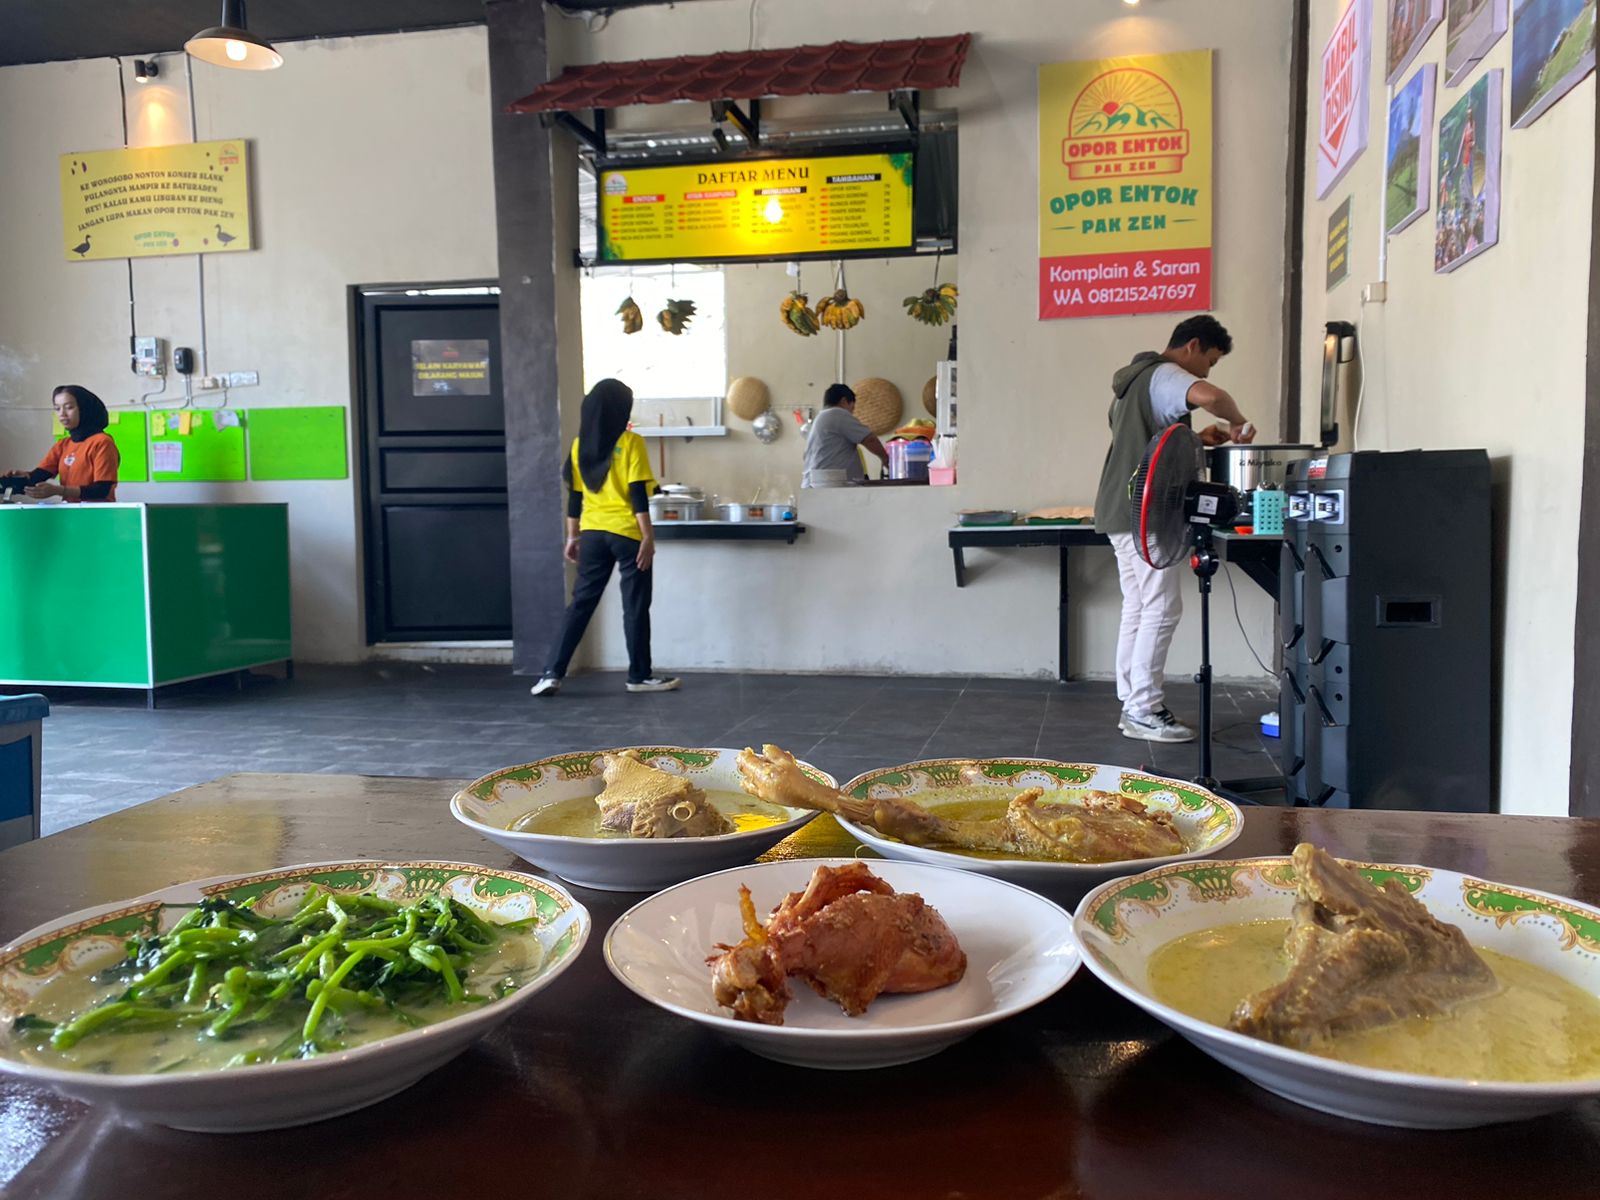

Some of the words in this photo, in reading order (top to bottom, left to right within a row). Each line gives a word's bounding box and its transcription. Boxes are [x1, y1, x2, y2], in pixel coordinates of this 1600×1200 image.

[1324, 10, 1358, 101] AMBIL
[1325, 60, 1353, 137] DISINI
[1068, 140, 1118, 158] OPOR
[1122, 136, 1184, 154] ENTOK
[697, 169, 758, 184] DAFTAR
[763, 166, 809, 181] MENU
[1094, 163, 1122, 174] PAK
[1129, 160, 1156, 172] ZEN
[80, 182, 90, 192] KE
[90, 172, 134, 188] WONOSOBO
[134, 170, 166, 179] NONTON
[167, 171, 198, 179] KONSER
[832, 174, 875, 182] TAMBAHAN
[84, 186, 128, 202] PULANGNYA
[129, 182, 159, 192] MAMPIR
[172, 182, 218, 192] BATURADEN
[103, 197, 128, 209] KALAU
[129, 195, 152, 203] KAMU
[153, 194, 187, 202] LIBURAN
[200, 195, 224, 205] DIENG
[1050, 187, 1113, 214] OPOR
[1120, 184, 1199, 206] ENTOK
[78, 216, 105, 232] JANGAN
[106, 212, 125, 222] LUPA
[126, 207, 152, 217] MAKAN
[153, 206, 175, 214] OPOR
[177, 206, 202, 215] ENTOK
[203, 208, 219, 217] PAK
[220, 210, 235, 219] ZEN
[1082, 217, 1121, 234] PAK
[1128, 214, 1166, 231] ZEN
[1049, 262, 1128, 283] Komplain
[1132, 260, 1148, 278] &
[1151, 259, 1200, 277] Saran
[1053, 288, 1084, 305] WA
[1088, 284, 1197, 304] 081215247697
[1248, 458, 1282, 468] Miyako
